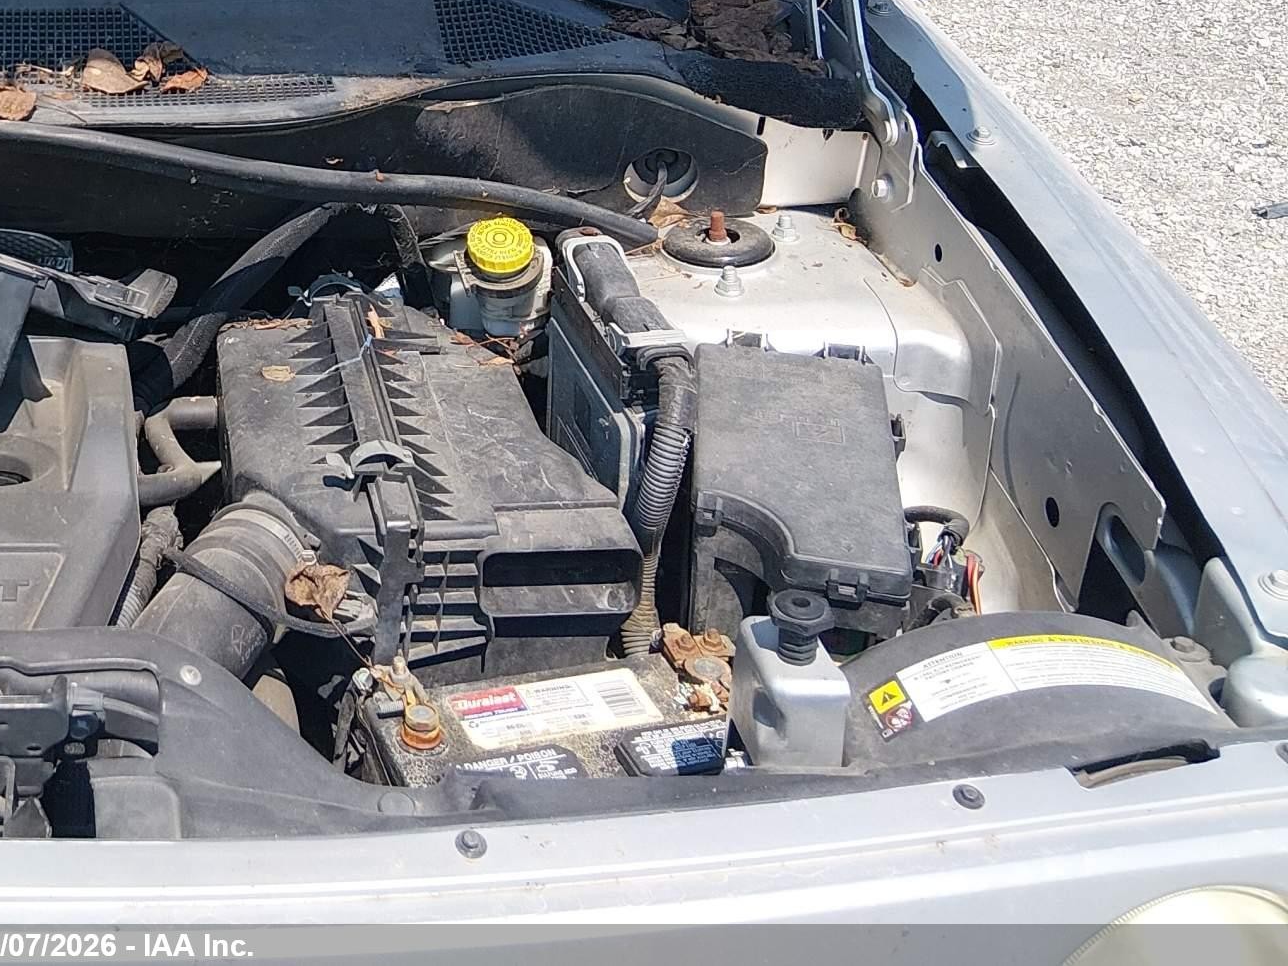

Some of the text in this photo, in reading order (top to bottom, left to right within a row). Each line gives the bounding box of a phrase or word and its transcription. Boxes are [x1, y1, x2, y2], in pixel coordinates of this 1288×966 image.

[452, 692, 518, 710] Duralast
[463, 757, 508, 771] DANGER
[516, 748, 558, 761] POISON
